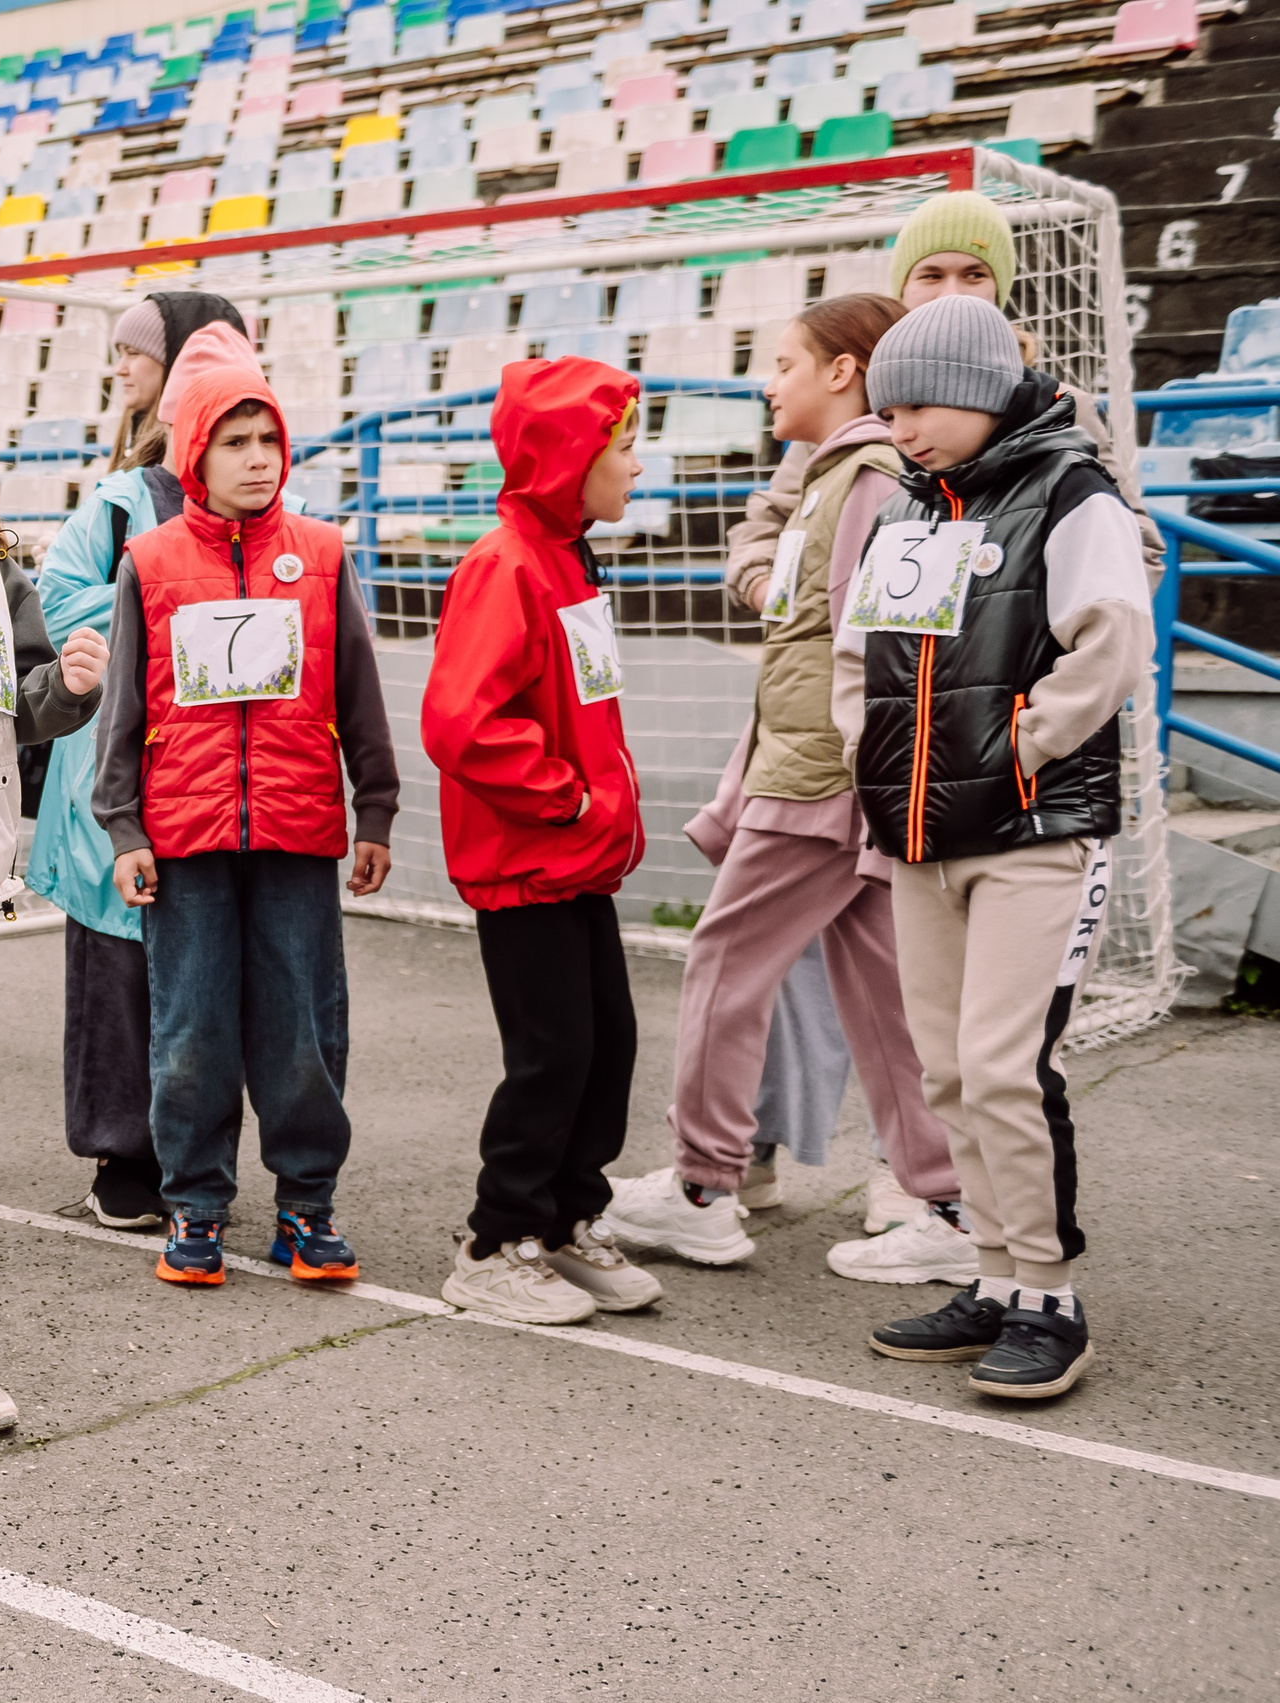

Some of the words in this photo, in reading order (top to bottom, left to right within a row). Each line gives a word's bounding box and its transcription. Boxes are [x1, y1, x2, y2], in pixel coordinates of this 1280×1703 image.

[1215, 163, 1250, 205] 7
[1157, 219, 1200, 269] 6
[886, 537, 929, 600] 3
[213, 612, 256, 675] 7
